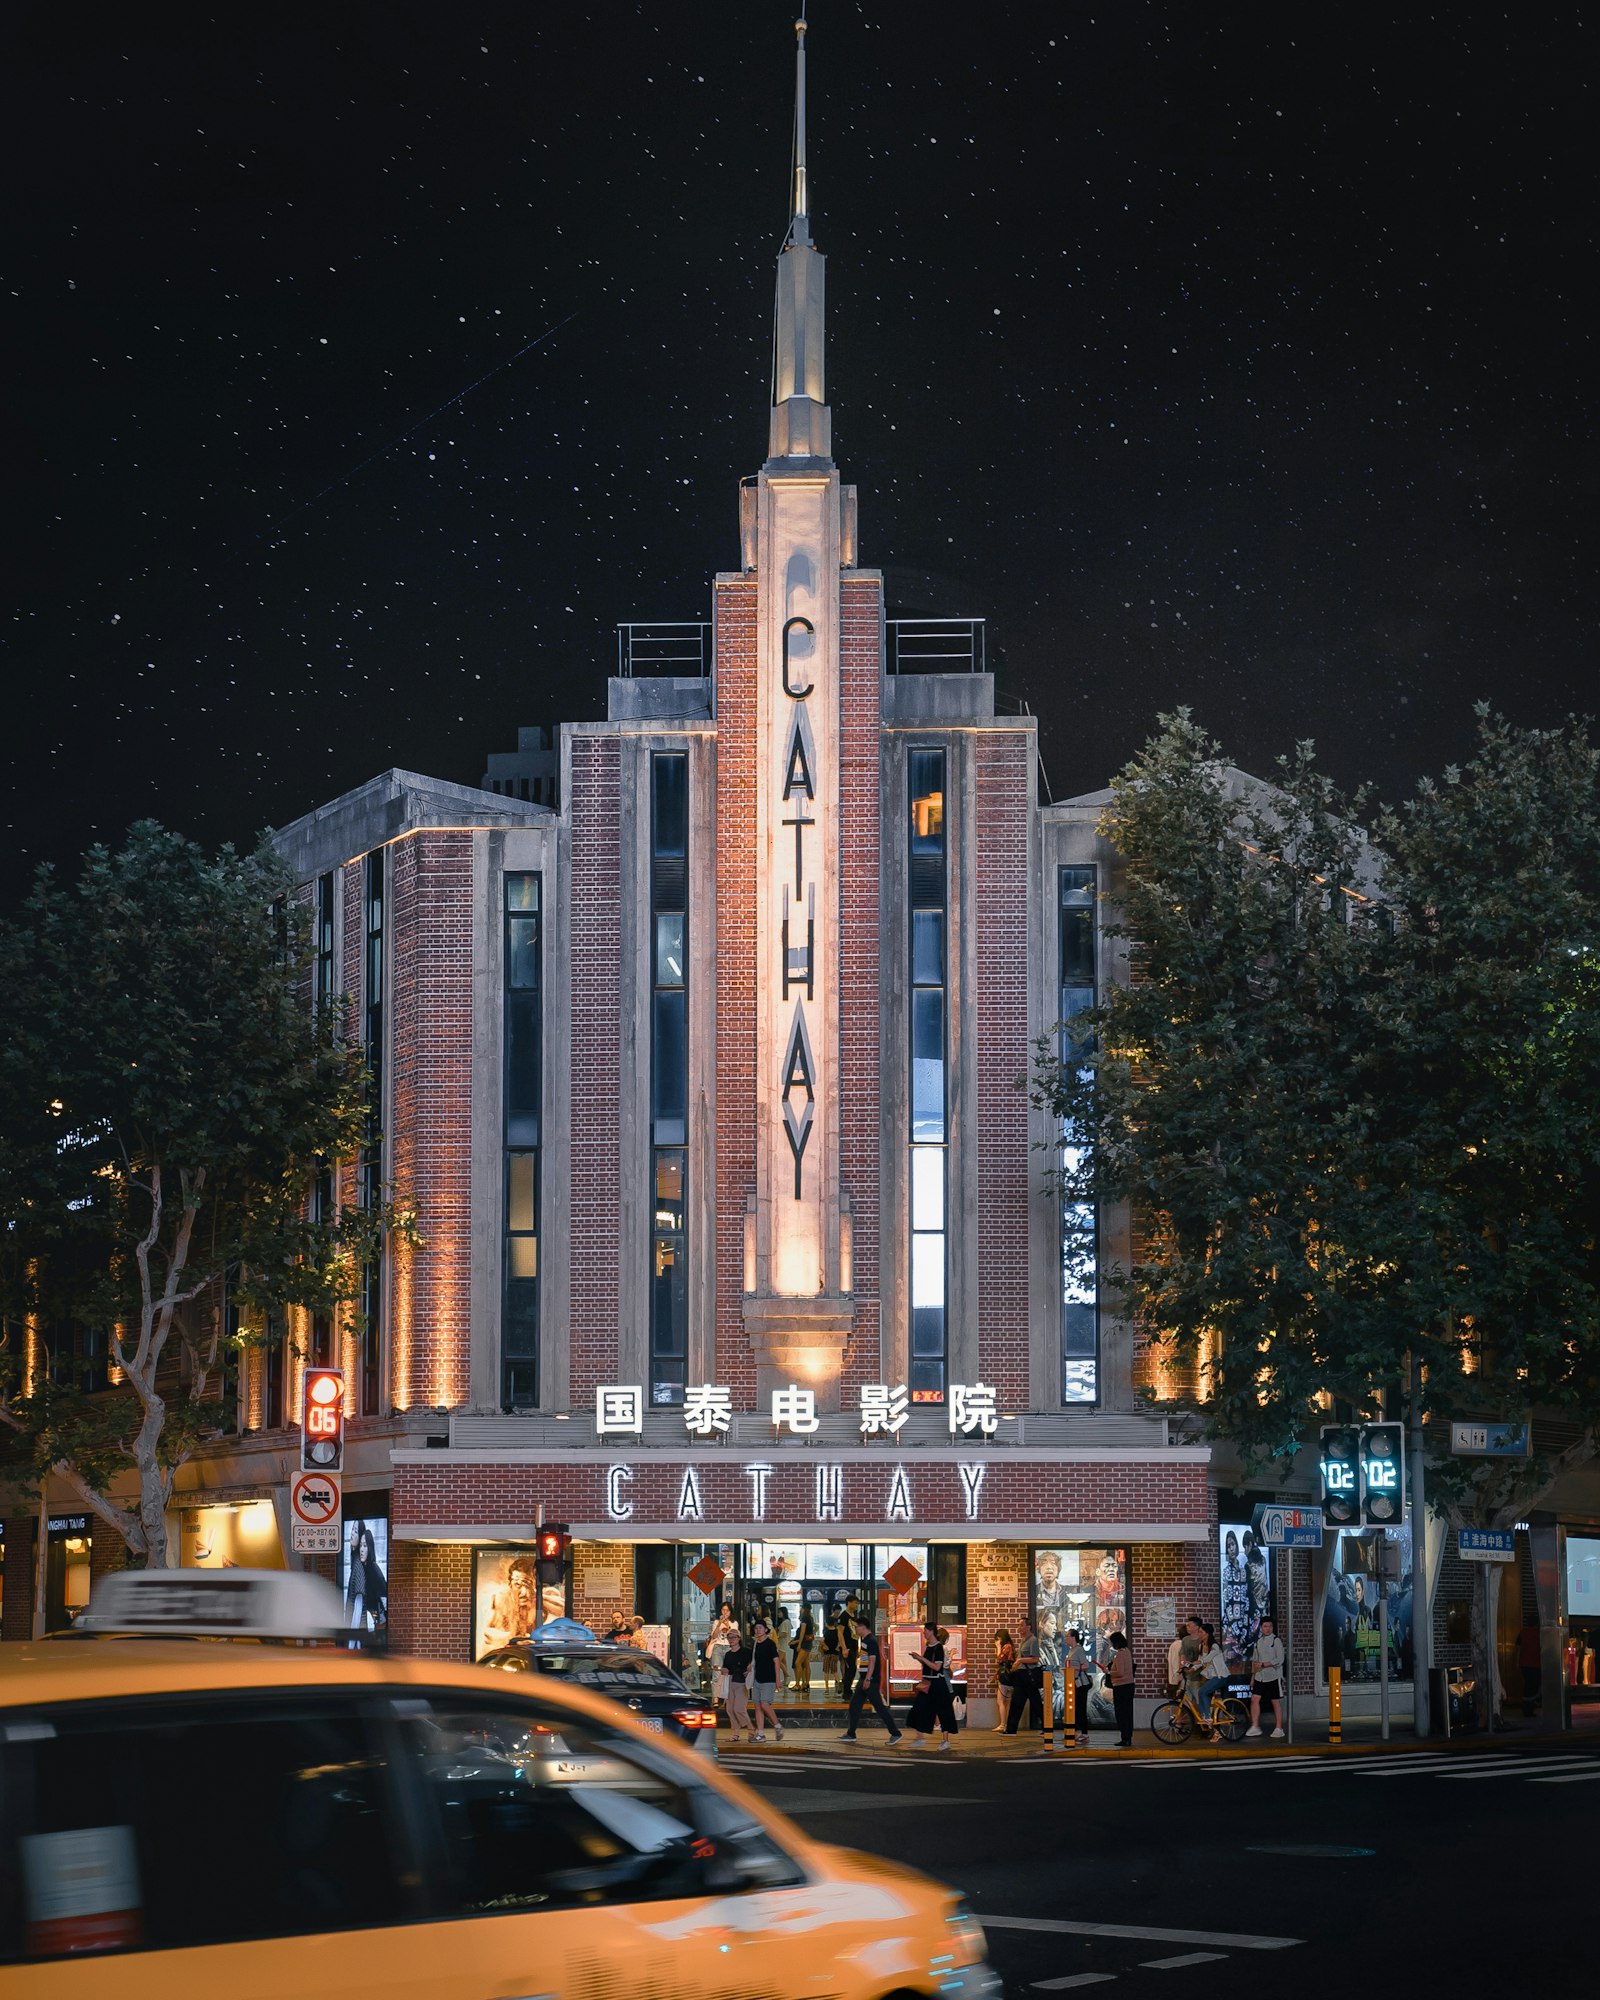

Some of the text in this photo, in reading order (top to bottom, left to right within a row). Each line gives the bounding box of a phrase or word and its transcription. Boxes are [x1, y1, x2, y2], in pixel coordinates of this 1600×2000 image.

[782, 616, 815, 1201] CATHAY
[309, 1406, 336, 1433] 06
[596, 1383, 998, 1435] 国泰电影院
[1328, 1463, 1354, 1489] 02
[1369, 1461, 1397, 1487] 02
[608, 1464, 984, 1519] CATHAY
[69, 1518, 85, 1529] TANG
[296, 1538, 337, 1549] 大型号牌
[1472, 1533, 1503, 1548] 淮海中路
[987, 1555, 1010, 1563] 870
